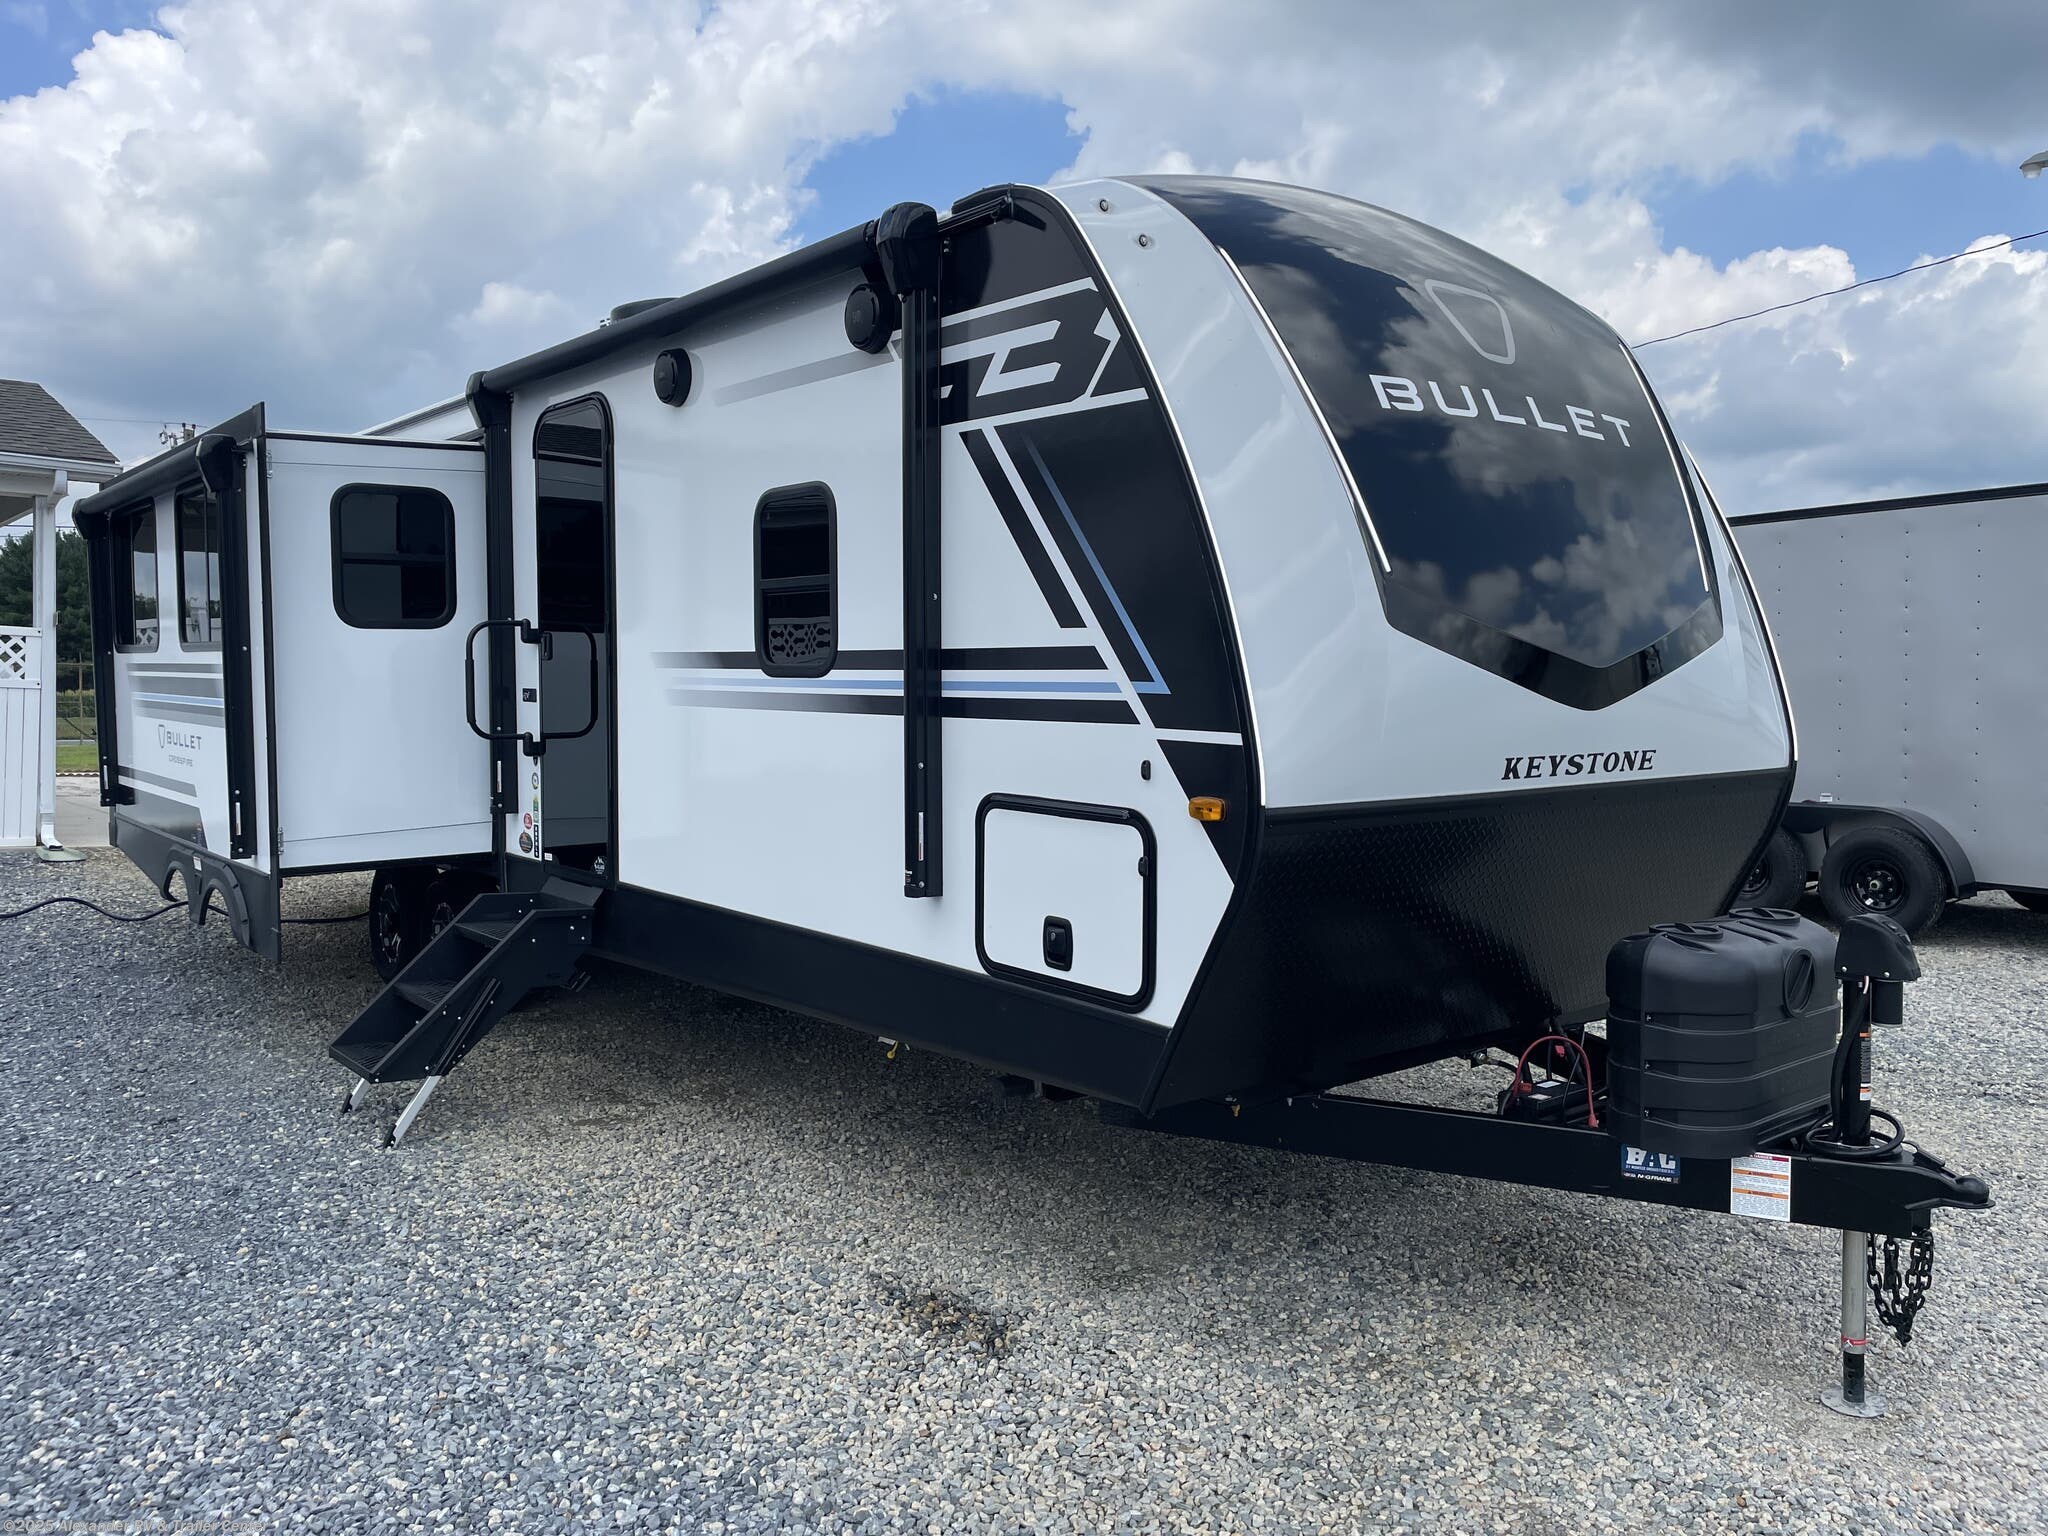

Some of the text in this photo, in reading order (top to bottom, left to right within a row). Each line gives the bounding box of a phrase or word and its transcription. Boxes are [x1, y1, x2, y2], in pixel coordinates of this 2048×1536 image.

[1368, 374, 1631, 447] BULLET
[166, 730, 202, 750] BULLET
[1501, 749, 1657, 780] KEYSTONE
